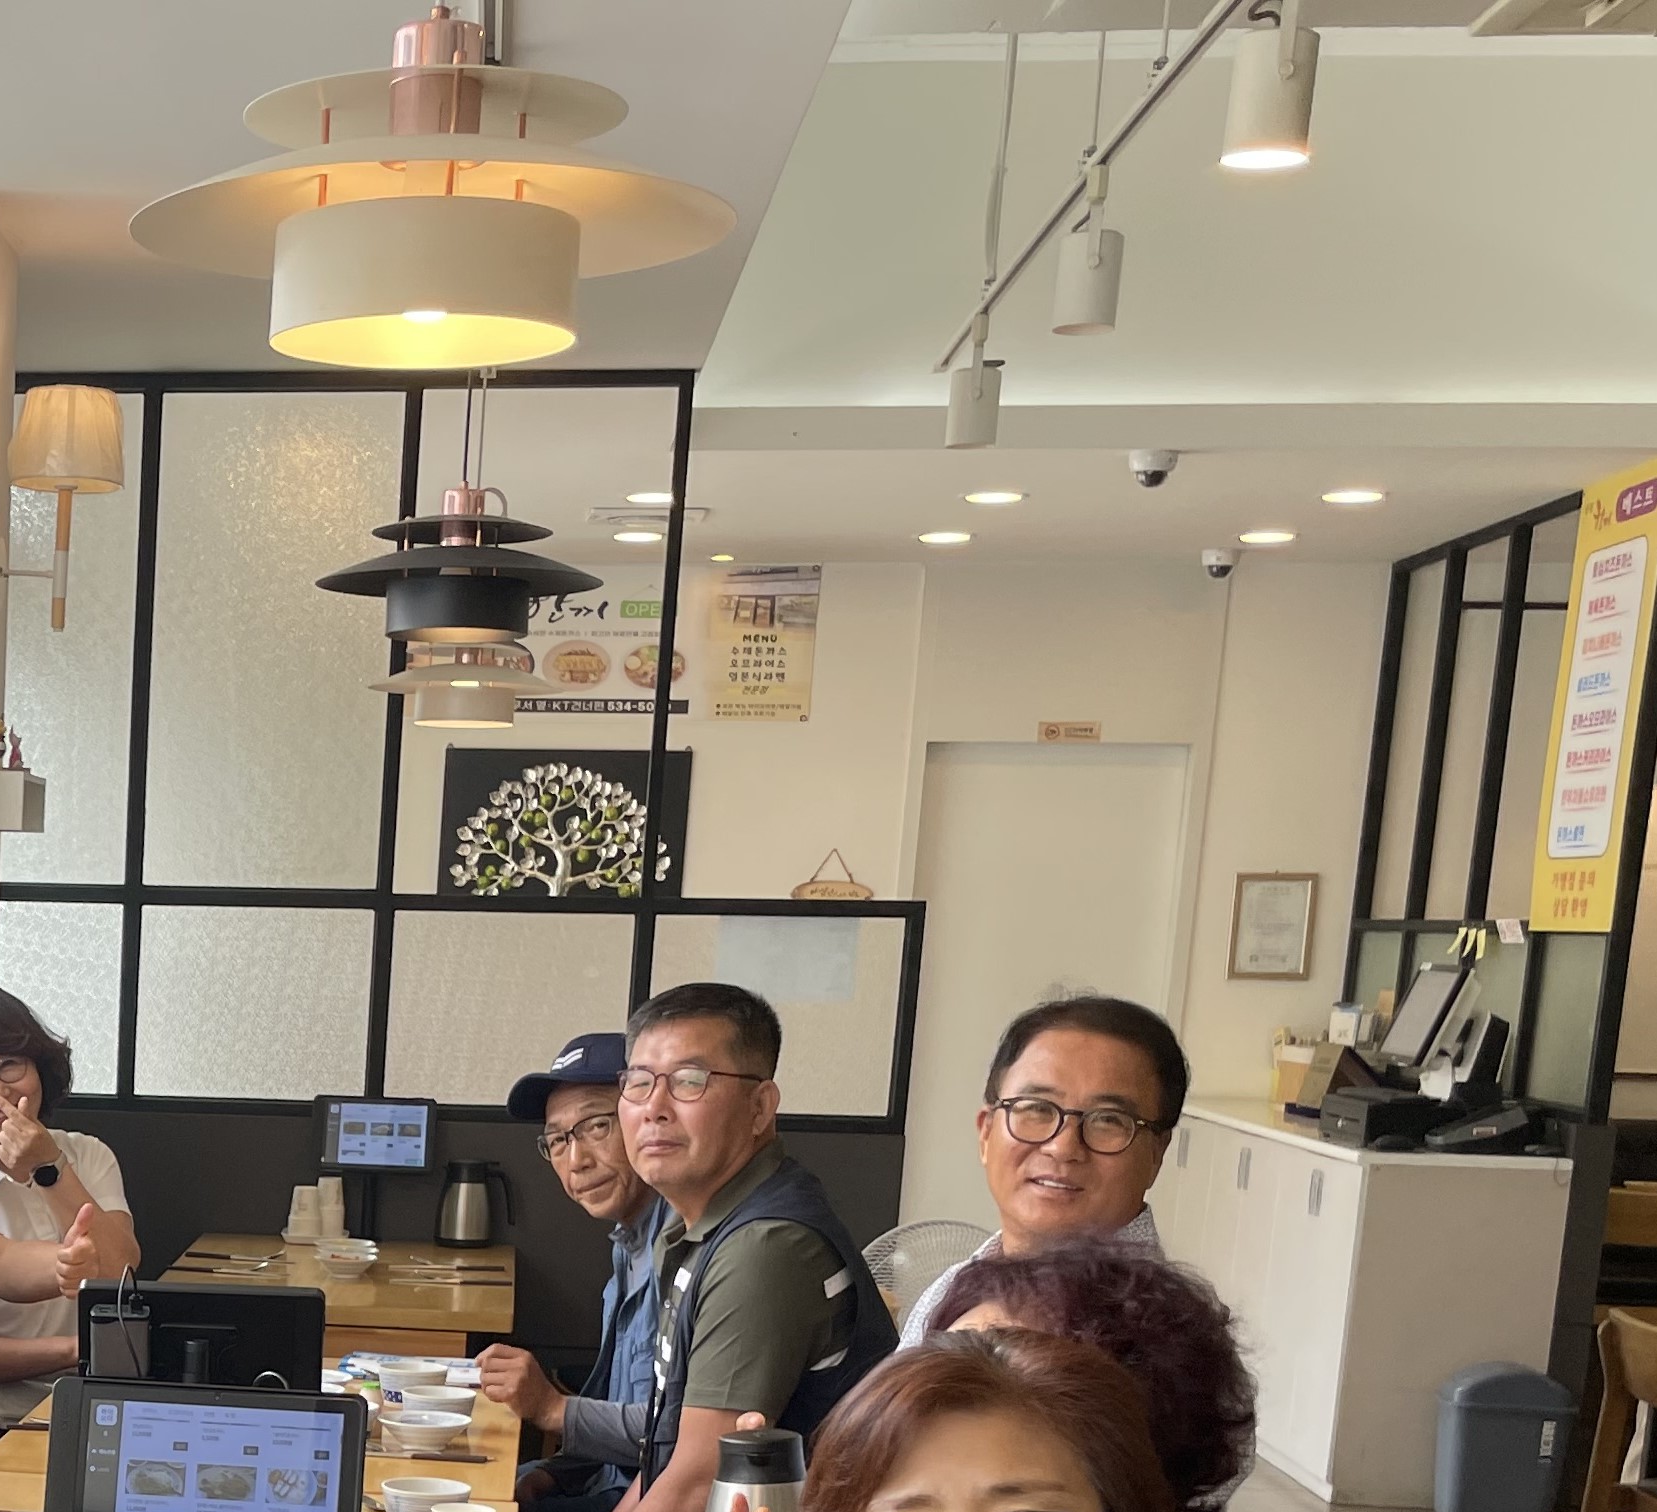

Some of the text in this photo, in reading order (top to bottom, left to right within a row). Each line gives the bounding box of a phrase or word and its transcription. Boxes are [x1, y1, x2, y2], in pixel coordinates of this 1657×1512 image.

[625, 602, 661, 616] OPE
[742, 634, 778, 643] MENU
[730, 646, 787, 657] 수제돈까스
[729, 659, 786, 668] 오므라이스
[607, 701, 672, 712] 534-50
